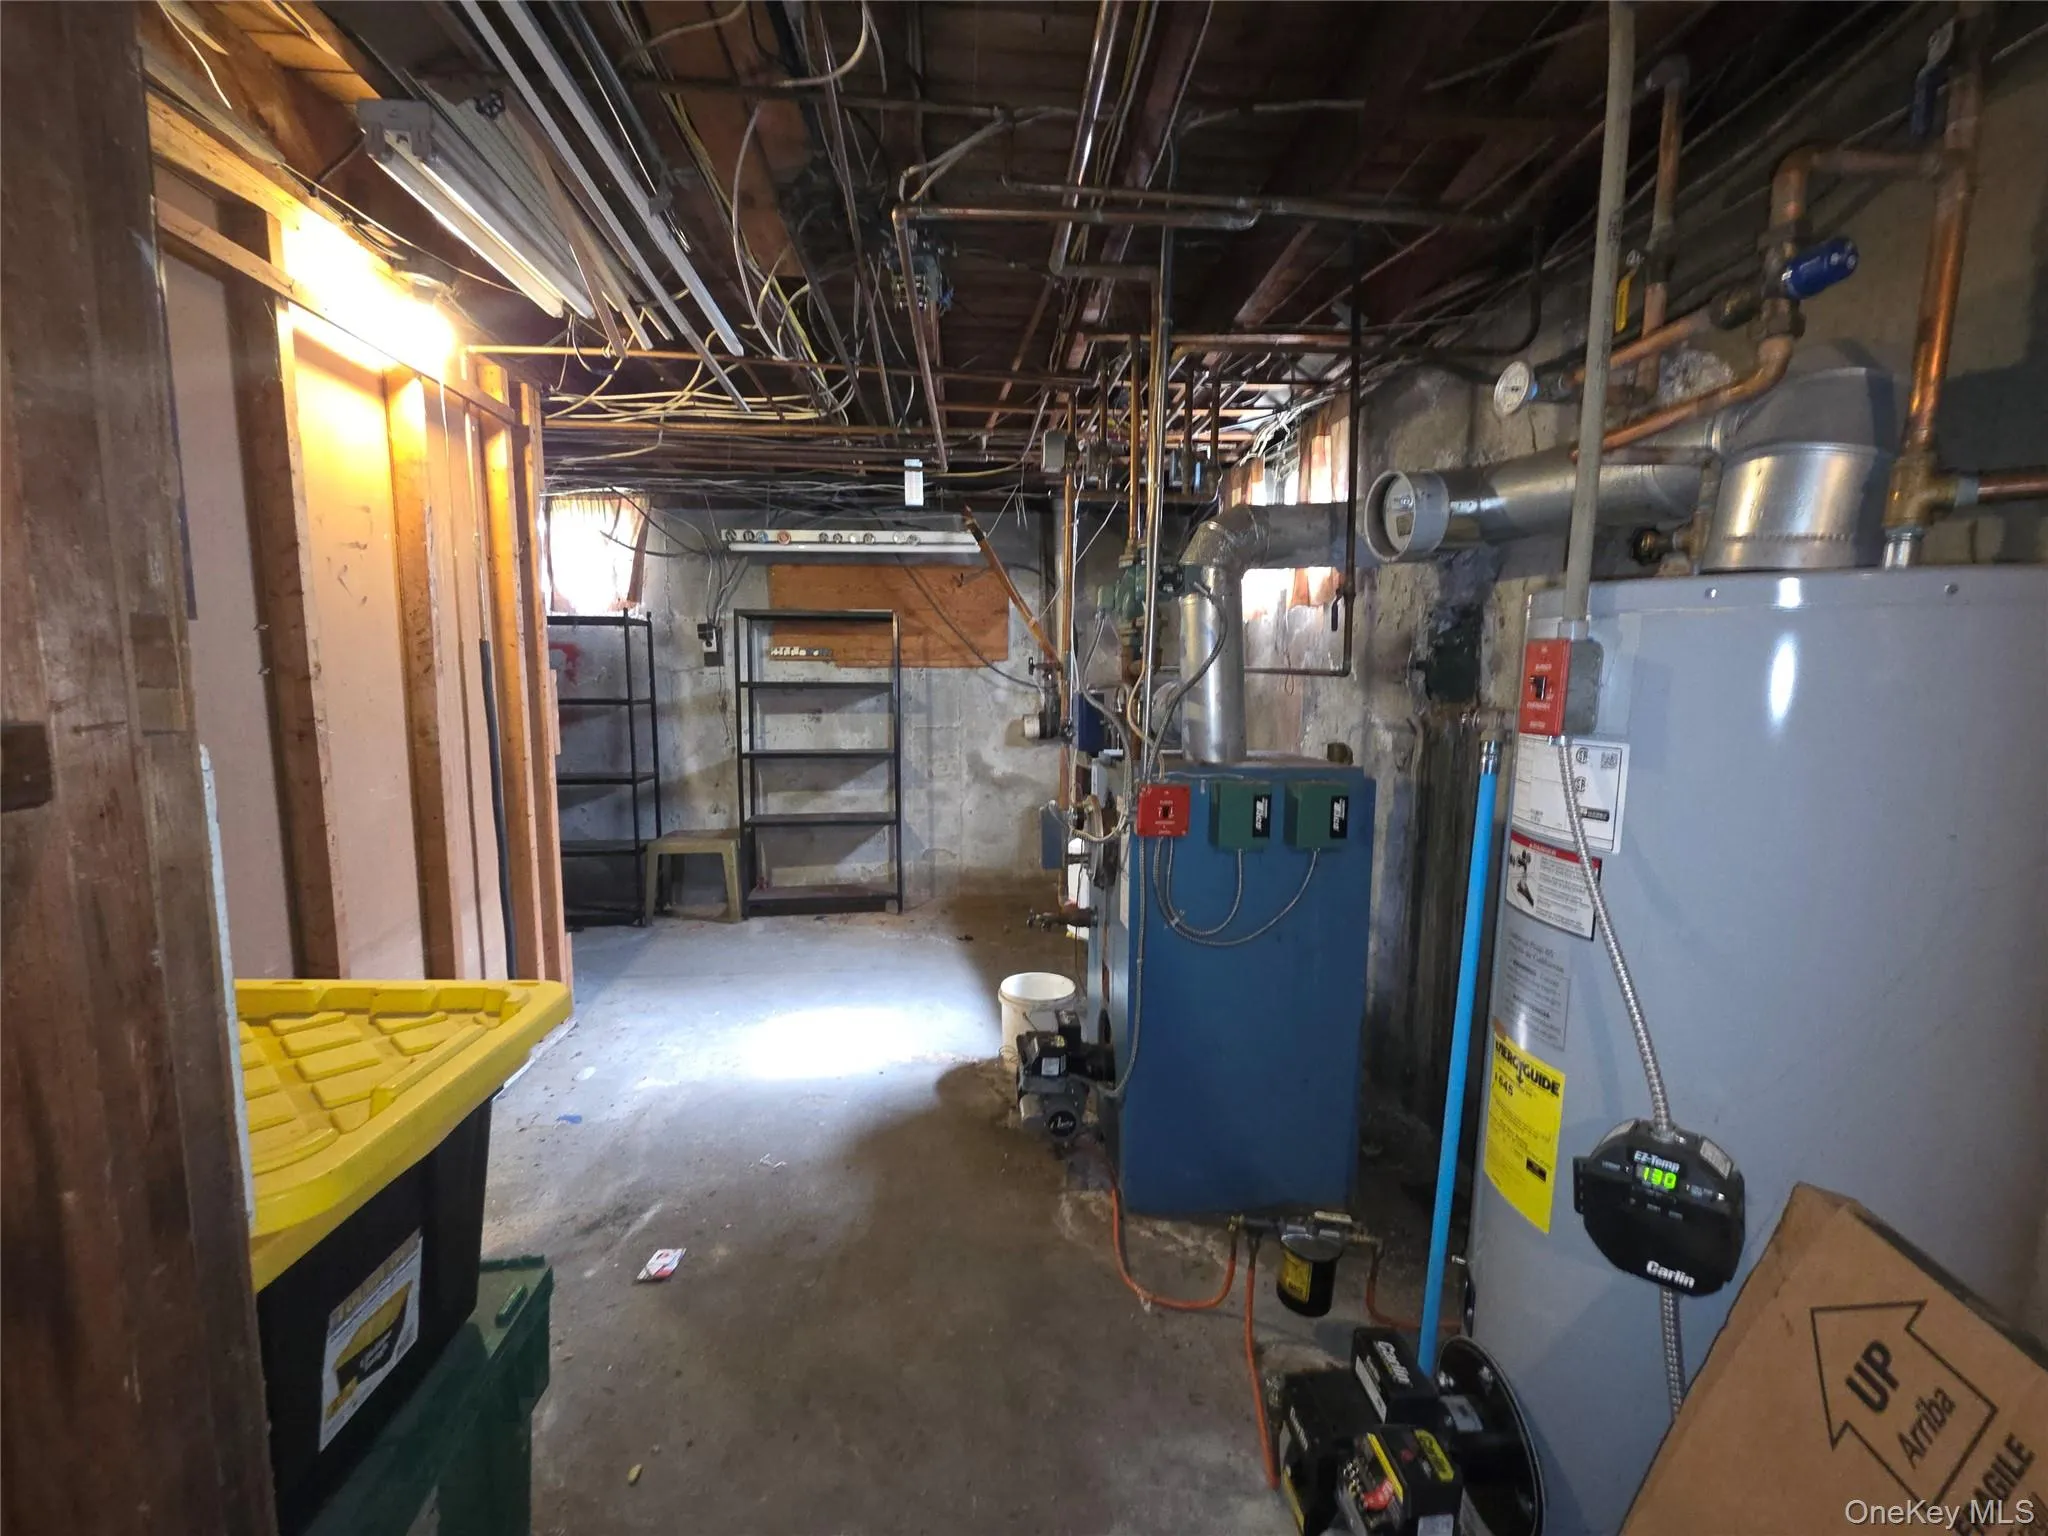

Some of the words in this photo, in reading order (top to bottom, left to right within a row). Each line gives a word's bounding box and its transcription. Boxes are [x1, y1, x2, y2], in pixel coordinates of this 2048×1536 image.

[1634, 1150, 1680, 1173] EZ-Temp
[1646, 1260, 1695, 1289] Carlin
[1845, 1340, 1899, 1413] UP
[1897, 1387, 1956, 1470] Arriba
